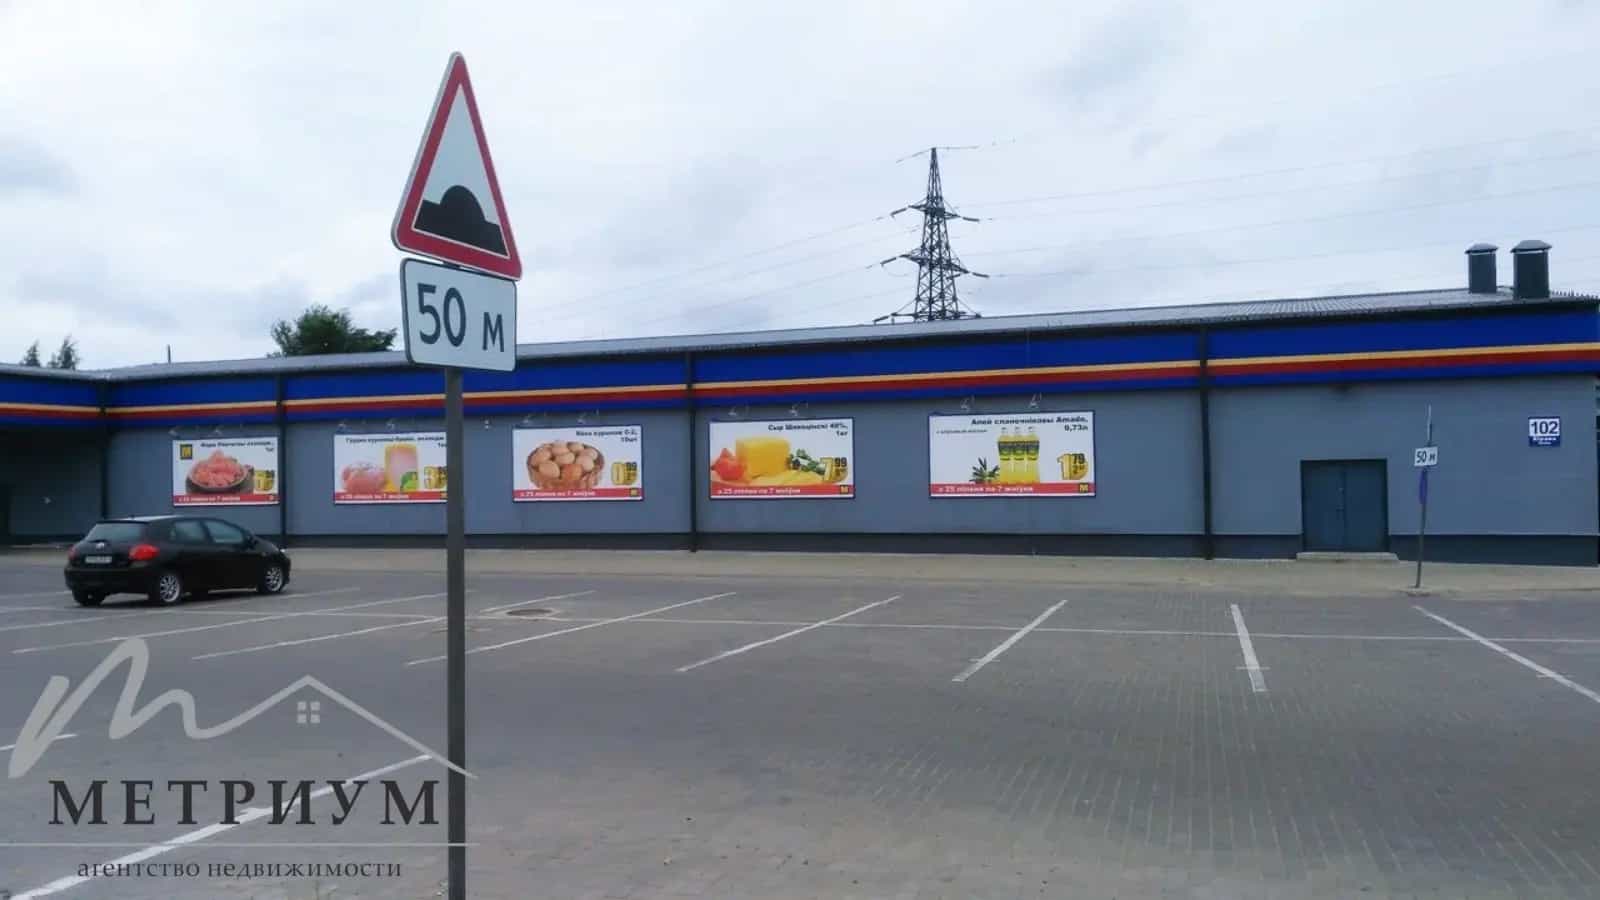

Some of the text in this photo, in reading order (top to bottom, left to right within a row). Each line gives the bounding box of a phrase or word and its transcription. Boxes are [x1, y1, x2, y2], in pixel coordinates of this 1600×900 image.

[417, 283, 467, 348] 50
[1530, 421, 1558, 434] 102
[1415, 450, 1427, 462] 50
